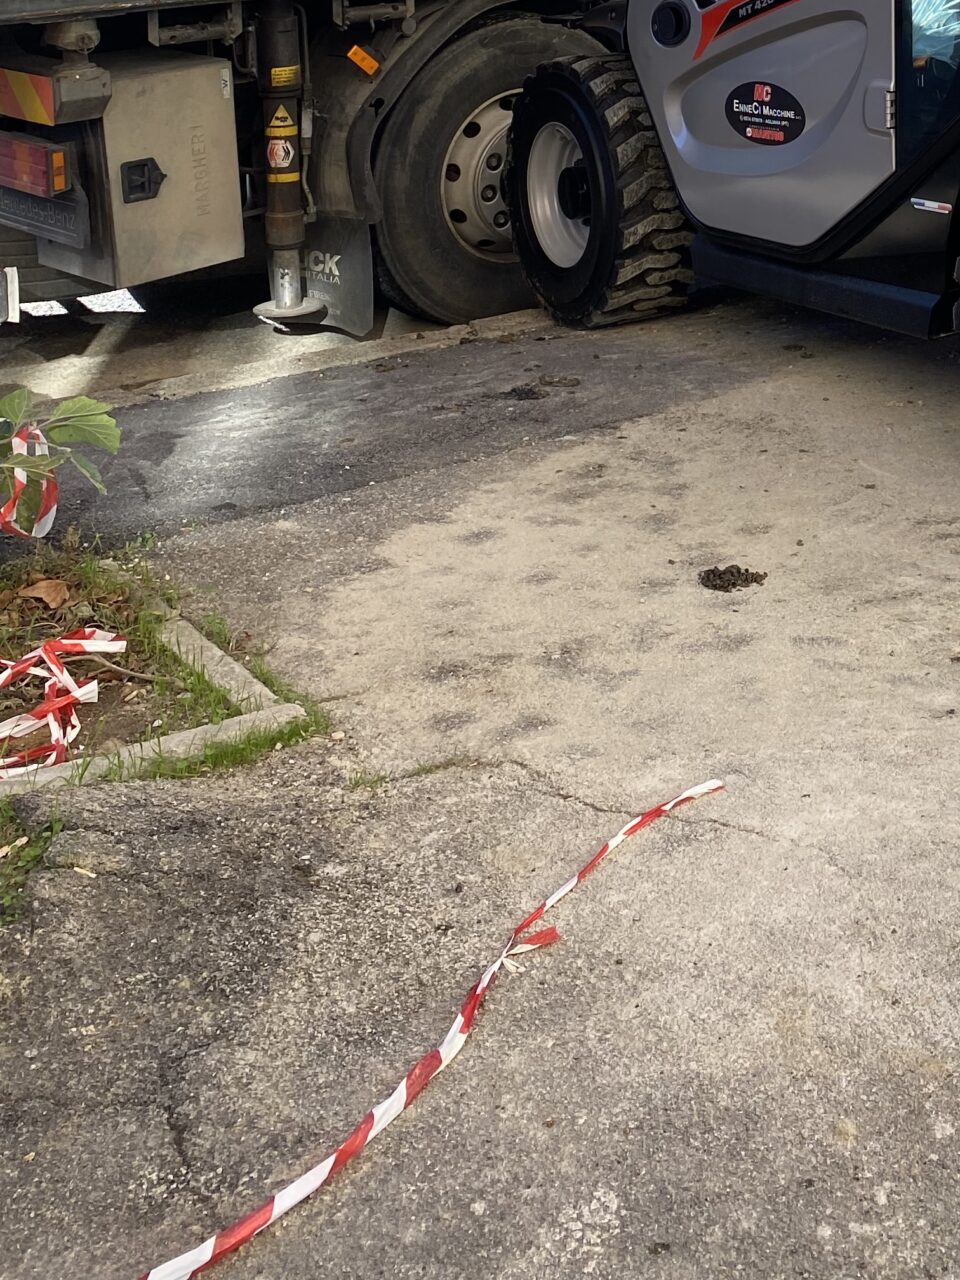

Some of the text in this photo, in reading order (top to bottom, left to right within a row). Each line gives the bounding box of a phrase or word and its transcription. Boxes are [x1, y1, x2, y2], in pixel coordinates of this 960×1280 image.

[738, 3, 753, 18] MT
[753, 83, 772, 102] NC
[305, 251, 342, 276] CK
